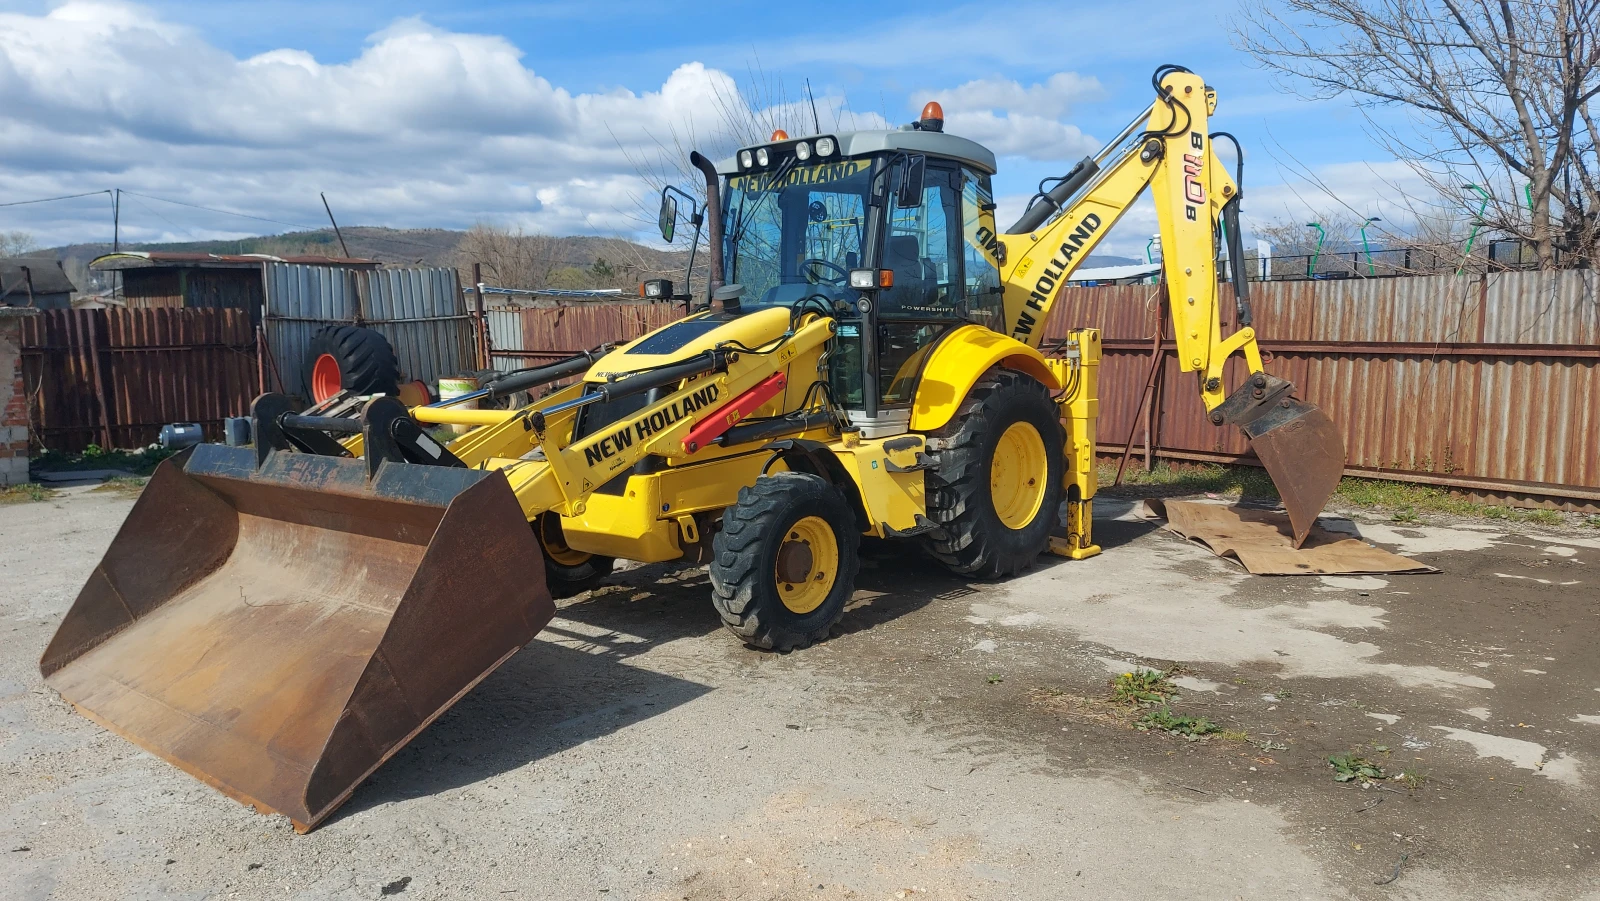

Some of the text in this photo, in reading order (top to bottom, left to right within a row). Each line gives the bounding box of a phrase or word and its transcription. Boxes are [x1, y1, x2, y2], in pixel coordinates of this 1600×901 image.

[1026, 212, 1101, 311] HOLLAND
[901, 305, 954, 313] POWERSHIFT
[584, 383, 719, 467] NEW HOLLAND
